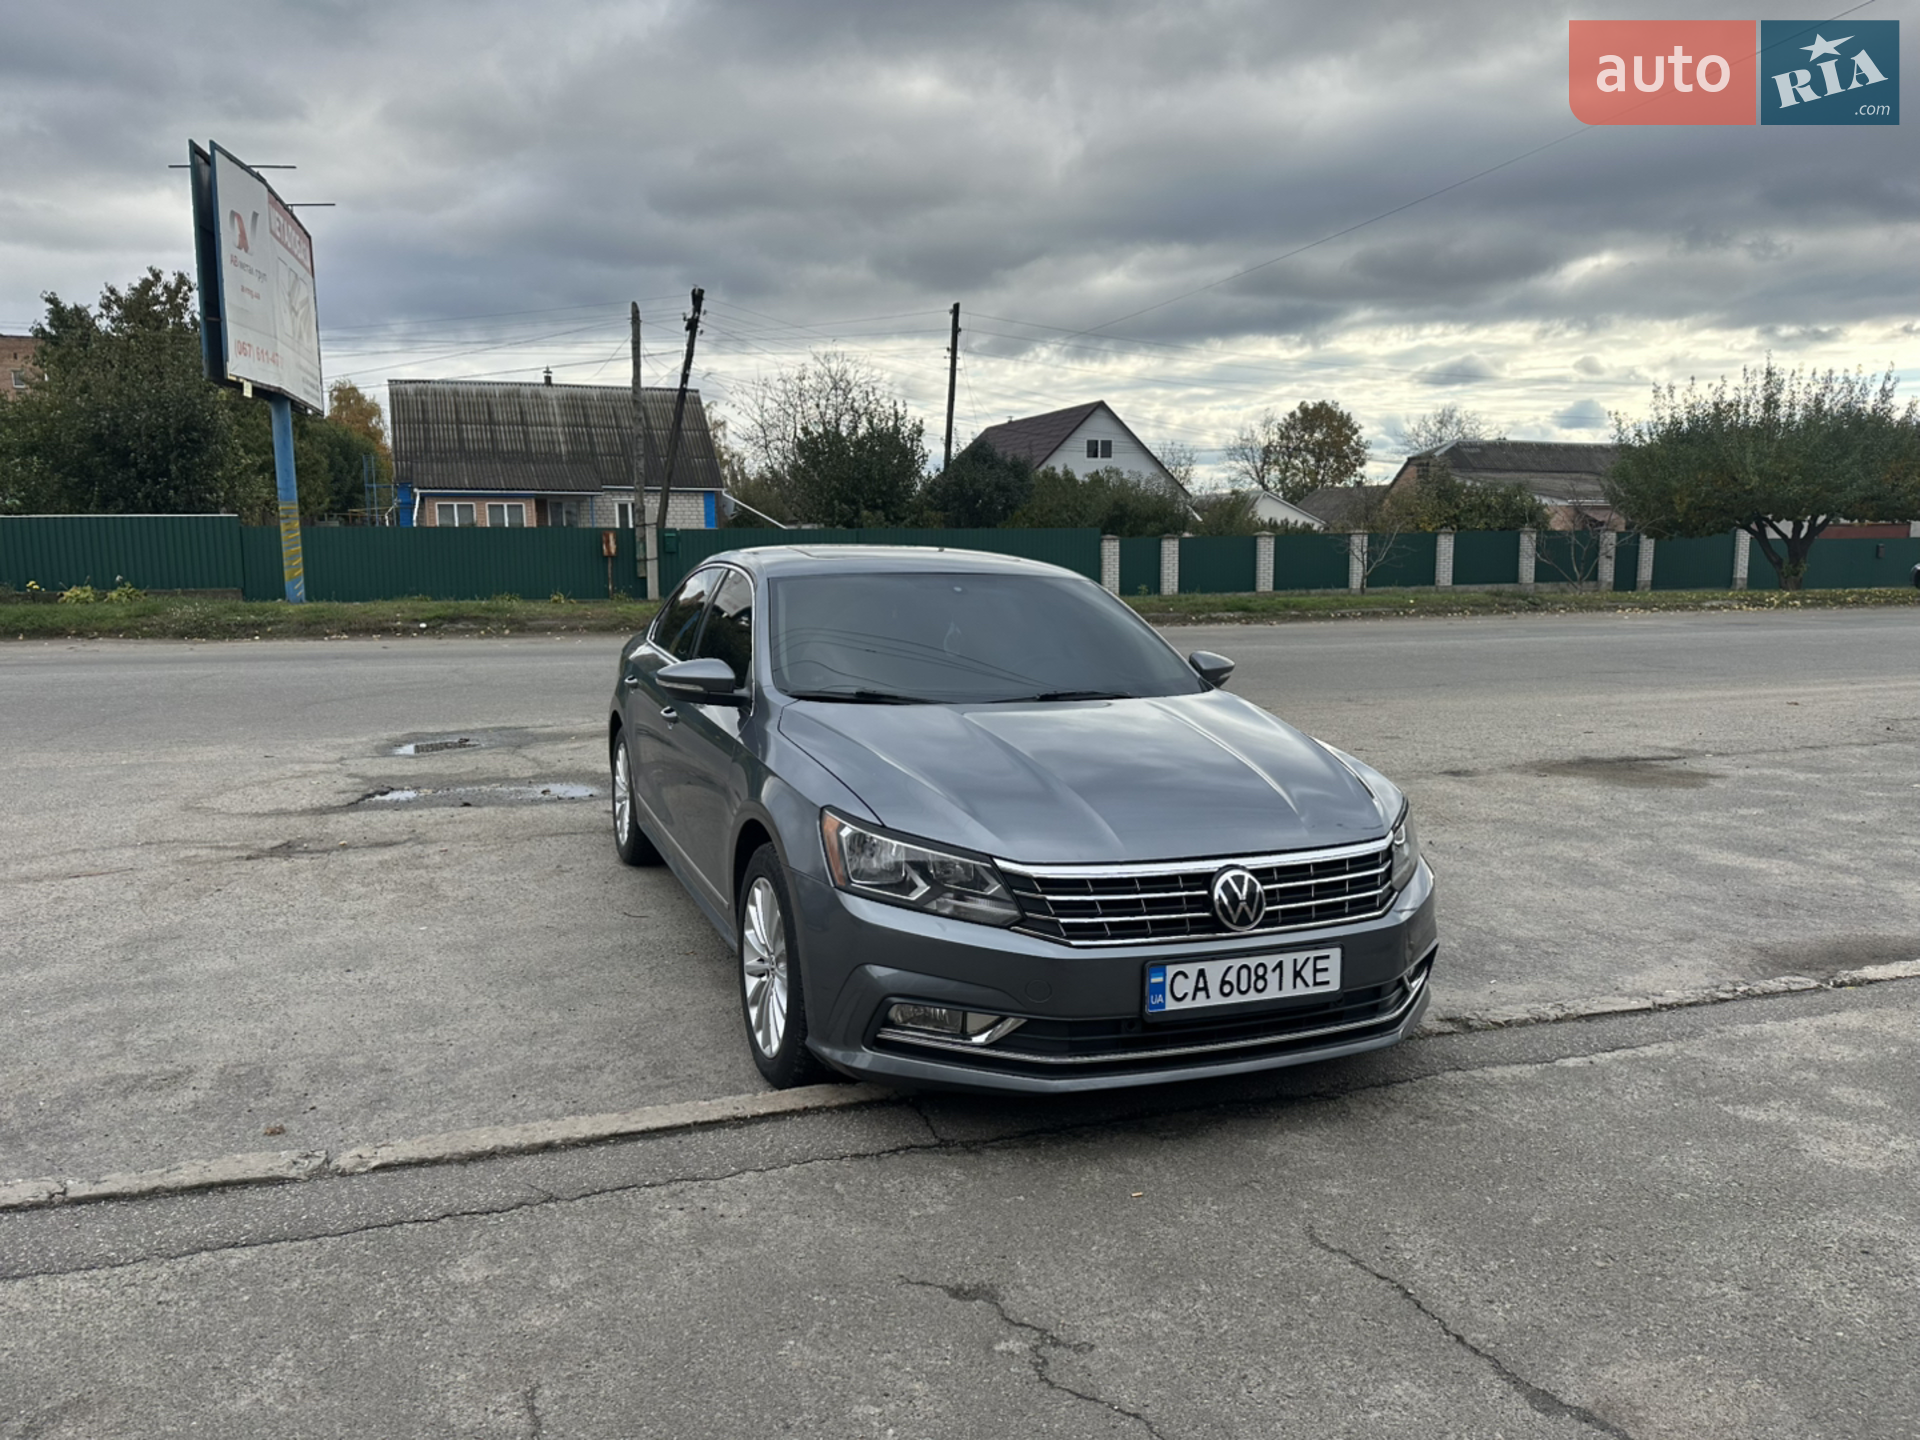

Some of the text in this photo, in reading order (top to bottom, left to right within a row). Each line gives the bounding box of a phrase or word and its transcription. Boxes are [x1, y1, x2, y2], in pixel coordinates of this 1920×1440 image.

[1170, 955, 1331, 1002] CA 6081 KE
[1151, 994, 1164, 1005] UA
